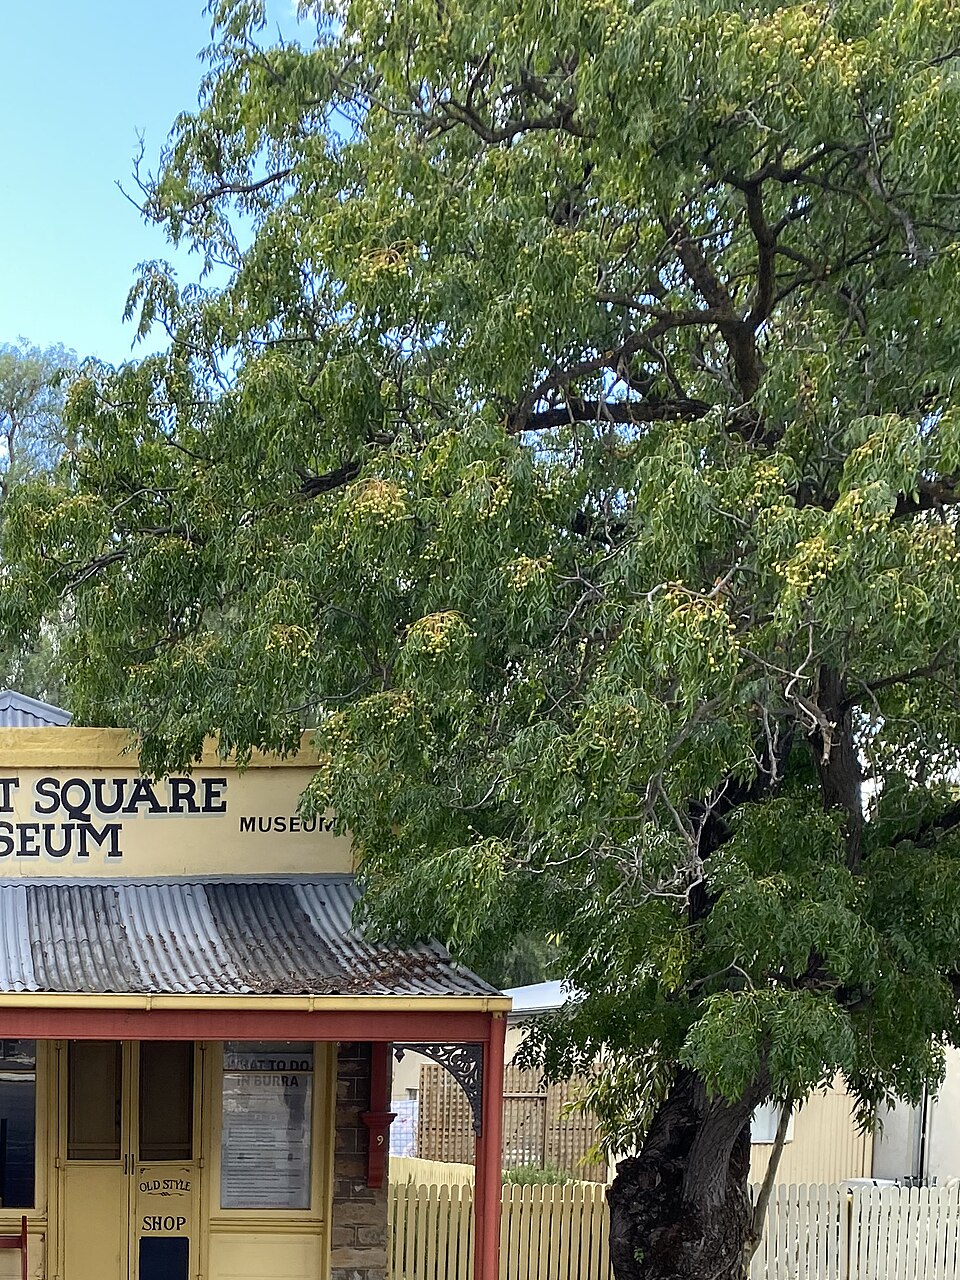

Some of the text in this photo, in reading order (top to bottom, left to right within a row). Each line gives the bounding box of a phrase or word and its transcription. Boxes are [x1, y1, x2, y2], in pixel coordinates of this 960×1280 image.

[34, 777, 228, 822] SQUARE
[269, 1059, 287, 1071] TO
[289, 1059, 310, 1071] DO
[237, 1075, 299, 1087] IN BURRA
[139, 1179, 191, 1193] OLD STYLE
[141, 1215, 187, 1231] SHOP
